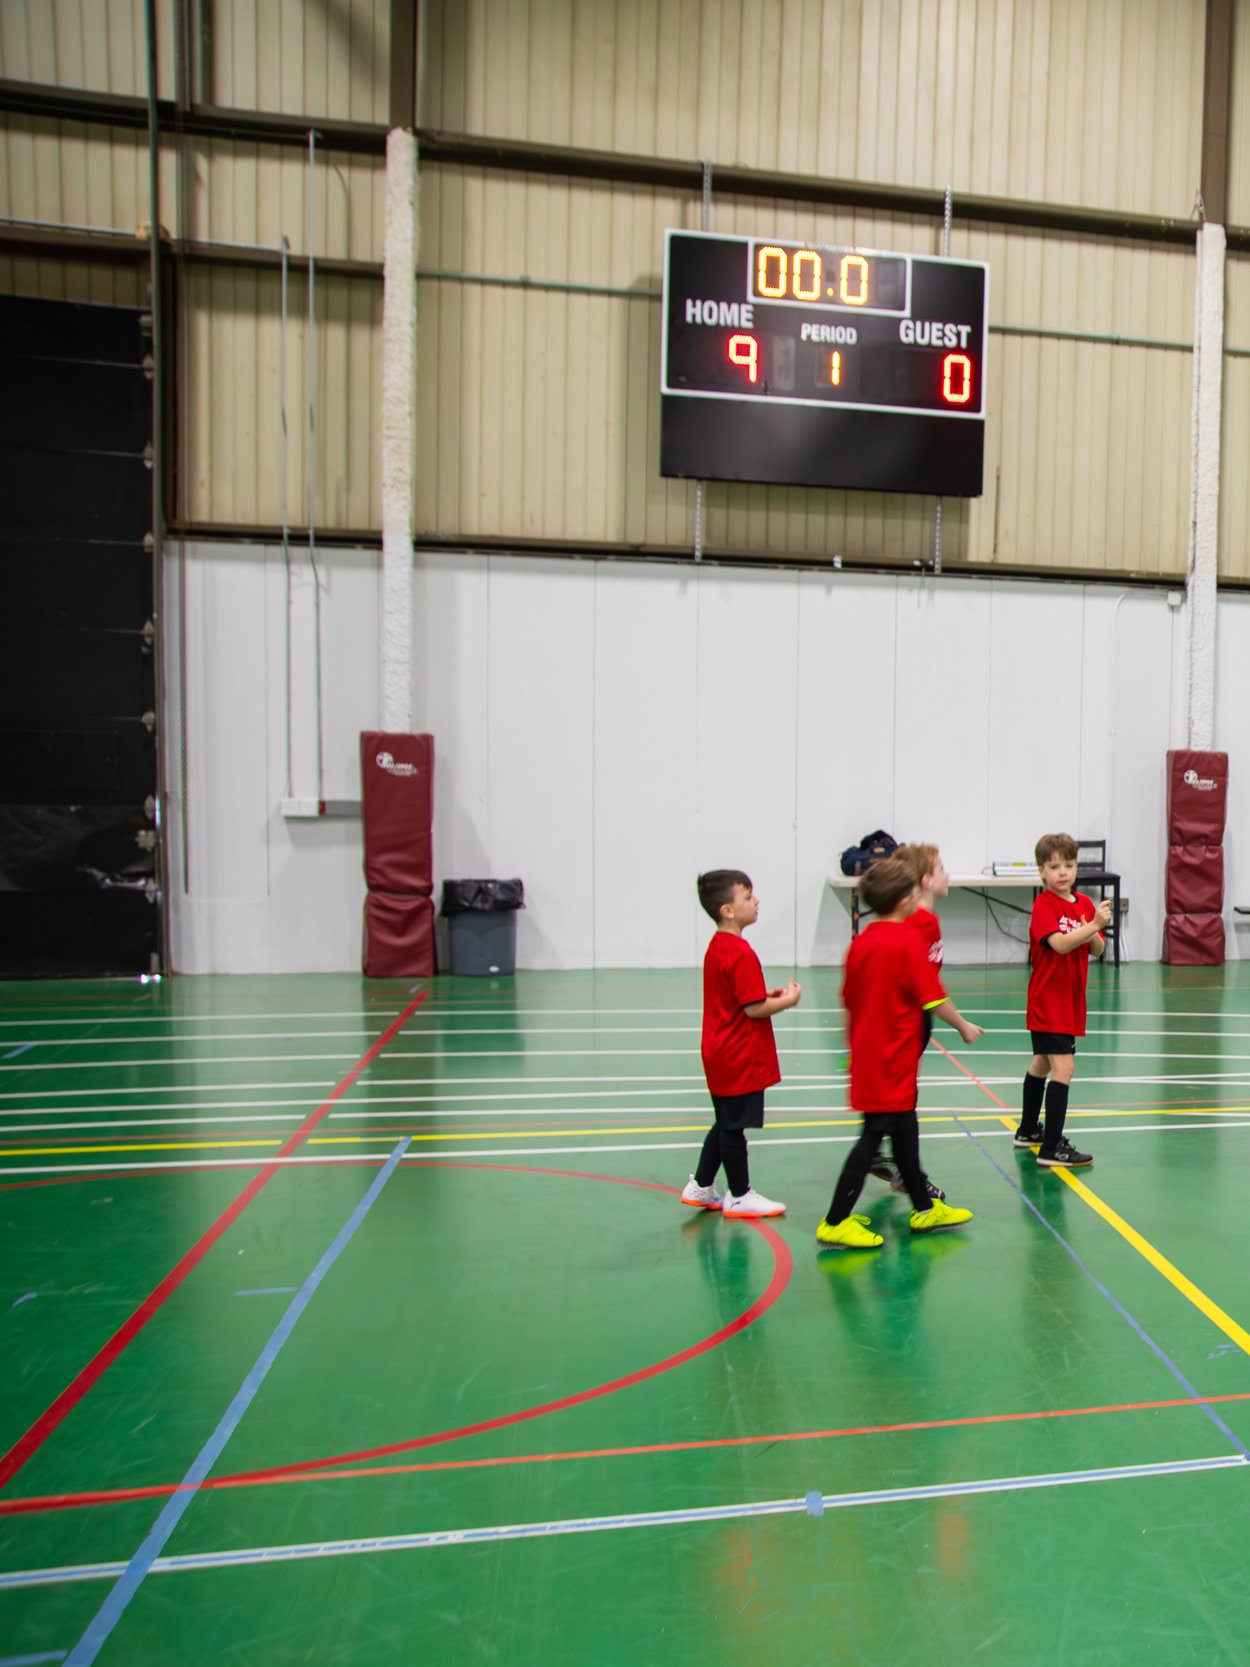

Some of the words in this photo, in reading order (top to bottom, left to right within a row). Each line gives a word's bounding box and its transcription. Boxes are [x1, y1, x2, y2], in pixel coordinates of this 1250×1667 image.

[758, 246, 869, 306] 00.0
[685, 299, 754, 329] HOME
[801, 323, 858, 345] PERIOD
[899, 319, 972, 350] GUEST
[728, 334, 758, 383] 9
[831, 350, 841, 386] 1
[943, 353, 971, 404] 0
